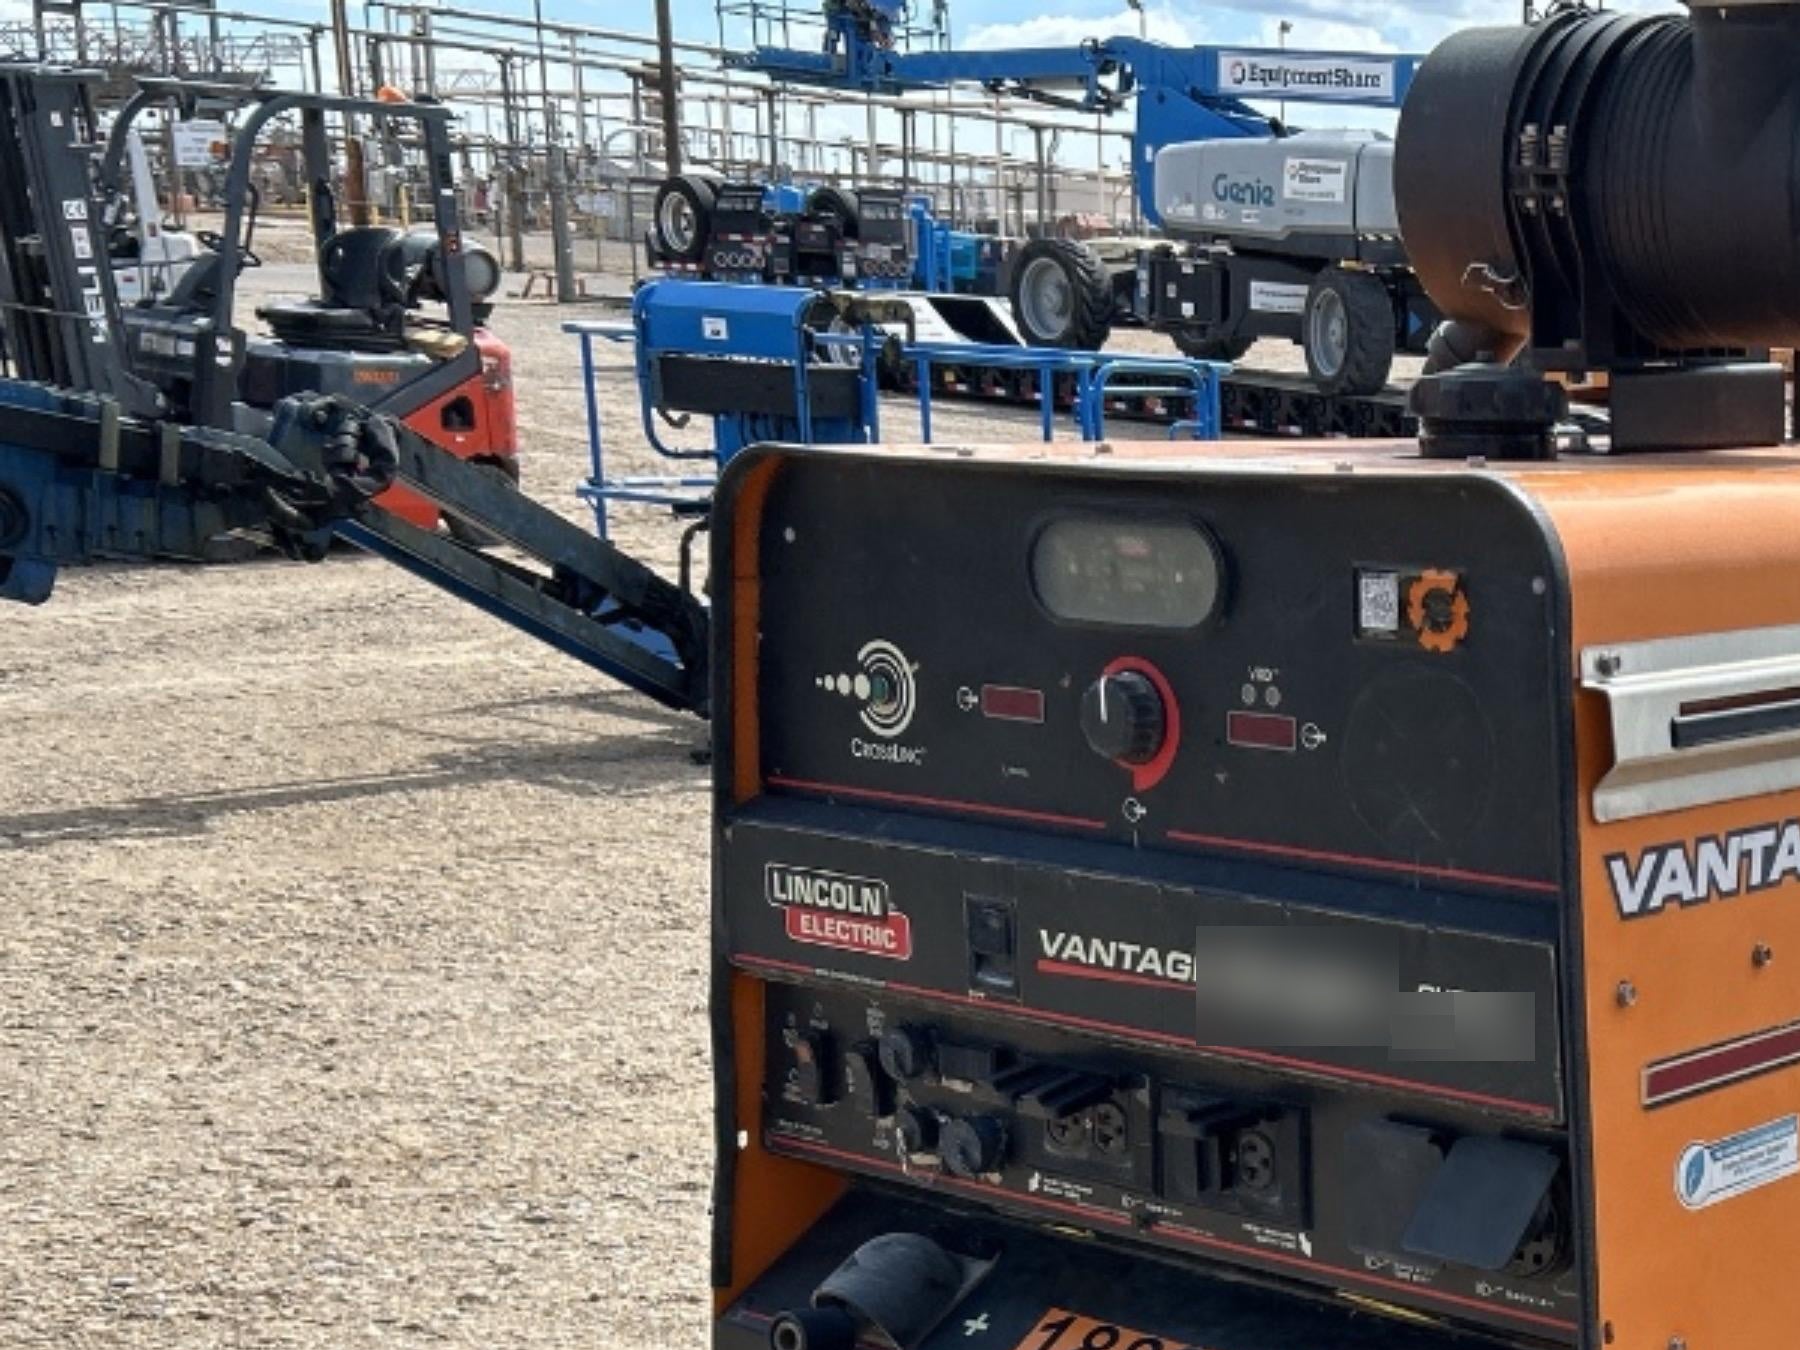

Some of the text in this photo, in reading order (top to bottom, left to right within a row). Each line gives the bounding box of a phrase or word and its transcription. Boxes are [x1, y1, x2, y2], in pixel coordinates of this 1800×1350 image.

[1248, 62, 1382, 88] EquipmentShare
[1212, 172, 1276, 207] Genie
[772, 870, 882, 916] LINCOLN
[800, 913, 897, 949] ELECTRIC
[1039, 928, 1196, 983] VANTAG
